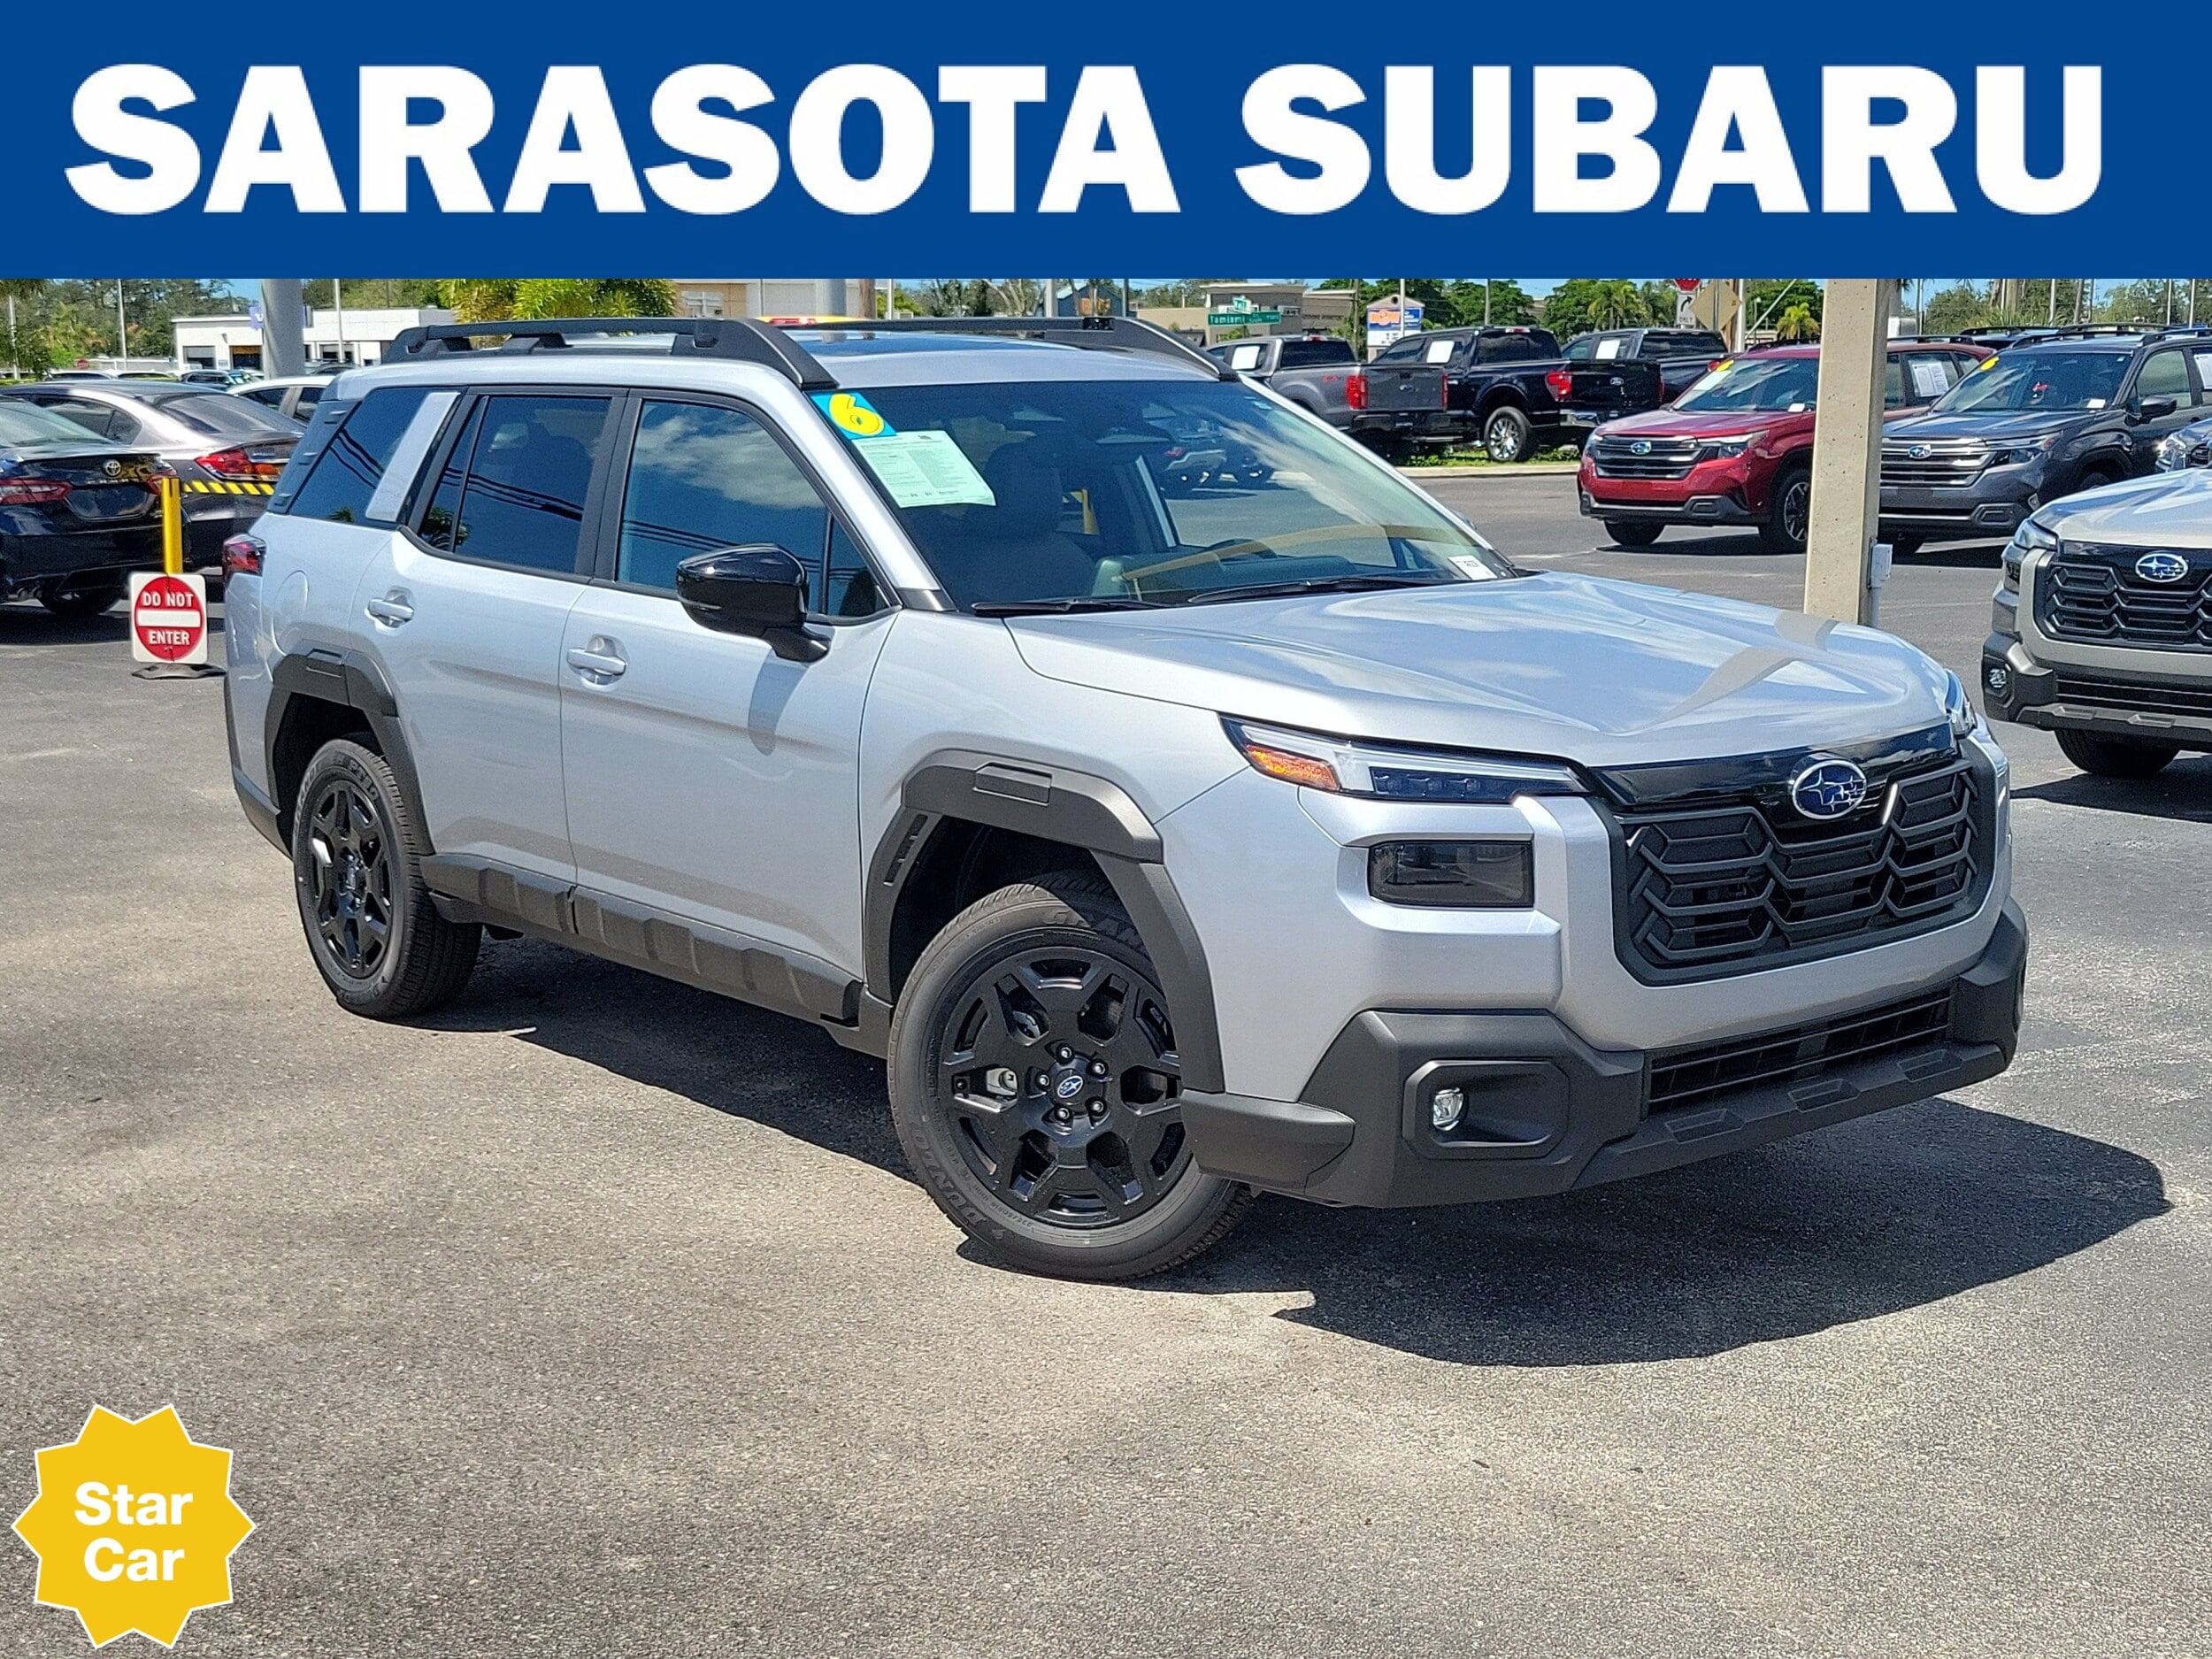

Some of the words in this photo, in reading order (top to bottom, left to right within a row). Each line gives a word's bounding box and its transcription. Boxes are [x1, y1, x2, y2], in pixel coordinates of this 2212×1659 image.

[828, 393, 885, 436] 6
[142, 592, 161, 607] DO
[165, 592, 194, 608] NOT
[148, 629, 191, 646] ENTER
